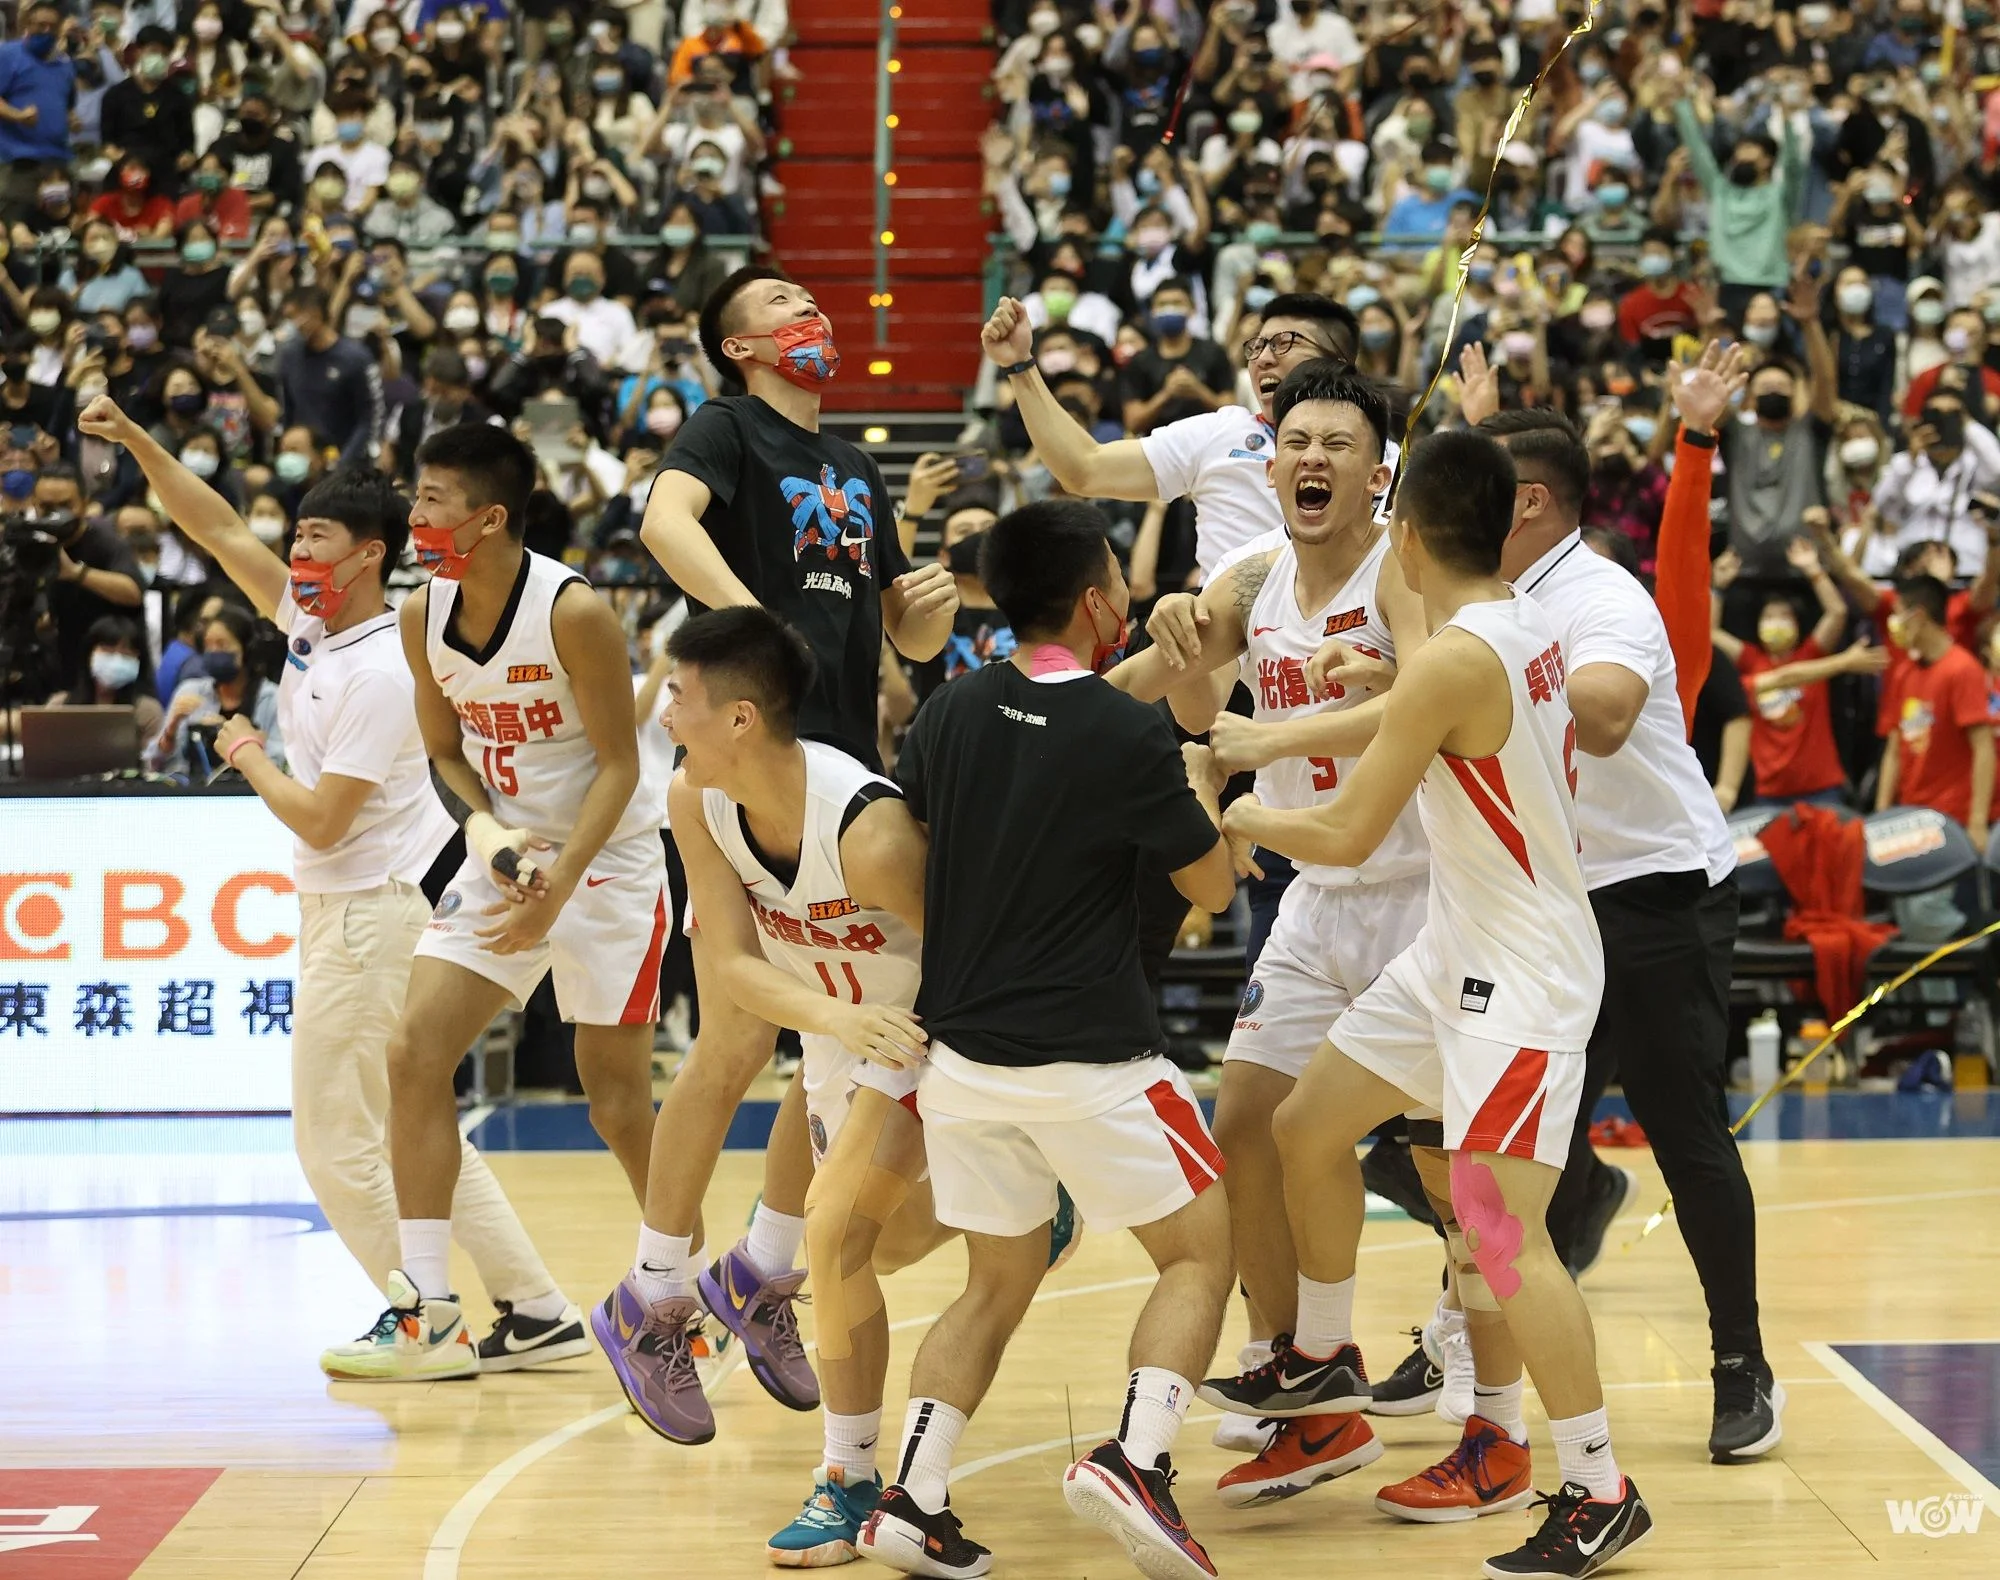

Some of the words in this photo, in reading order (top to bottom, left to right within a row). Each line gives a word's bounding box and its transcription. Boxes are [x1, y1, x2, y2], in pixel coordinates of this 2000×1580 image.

[1323, 606, 1368, 636] HBL
[507, 664, 552, 684] HBL
[1258, 644, 1381, 710] 光復
[483, 745, 519, 796] 15
[0, 869, 297, 960] EBC
[807, 898, 860, 921] HBL
[815, 961, 863, 1005] 11
[1473, 982, 1479, 992] L
[0, 979, 293, 1037] 東森超視
